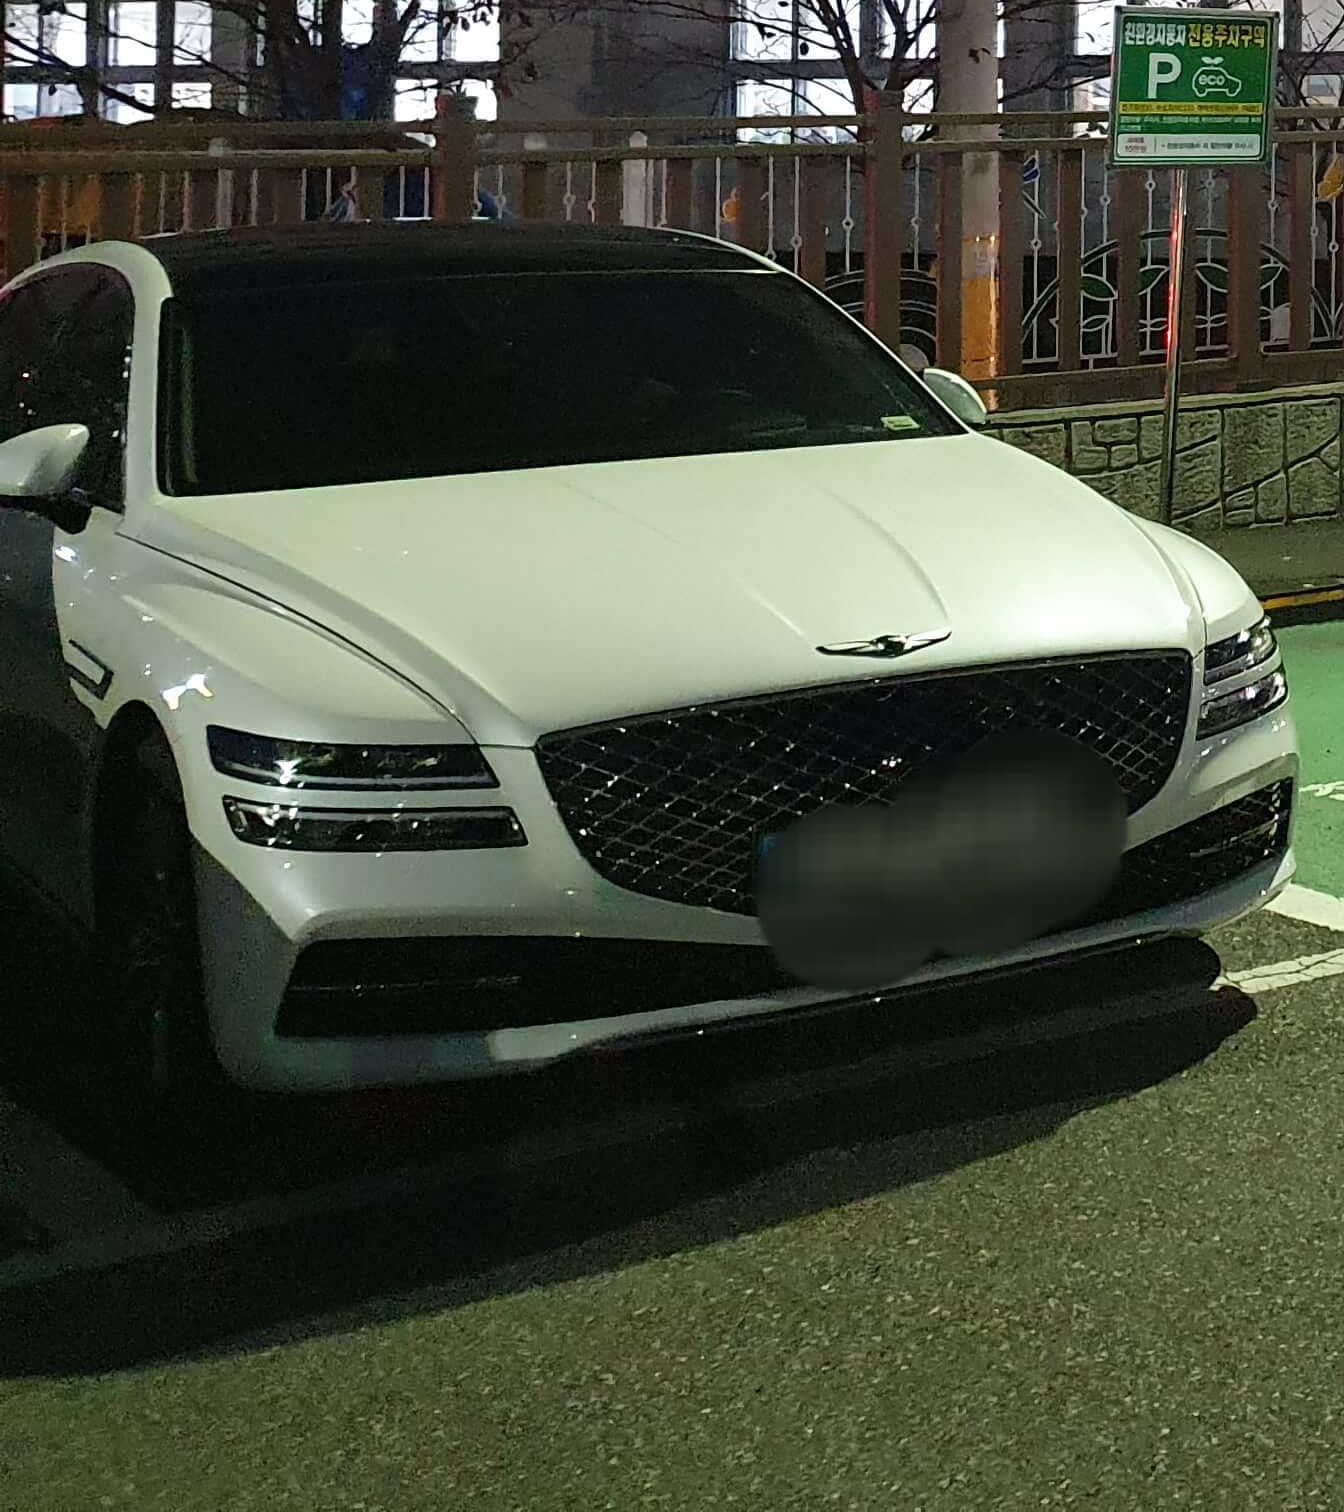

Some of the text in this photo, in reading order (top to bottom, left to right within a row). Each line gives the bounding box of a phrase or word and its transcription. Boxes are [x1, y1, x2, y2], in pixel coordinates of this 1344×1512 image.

[1124, 22, 1265, 48] 친환경자동차 전용주차구역
[1147, 52, 1225, 99] P eco
